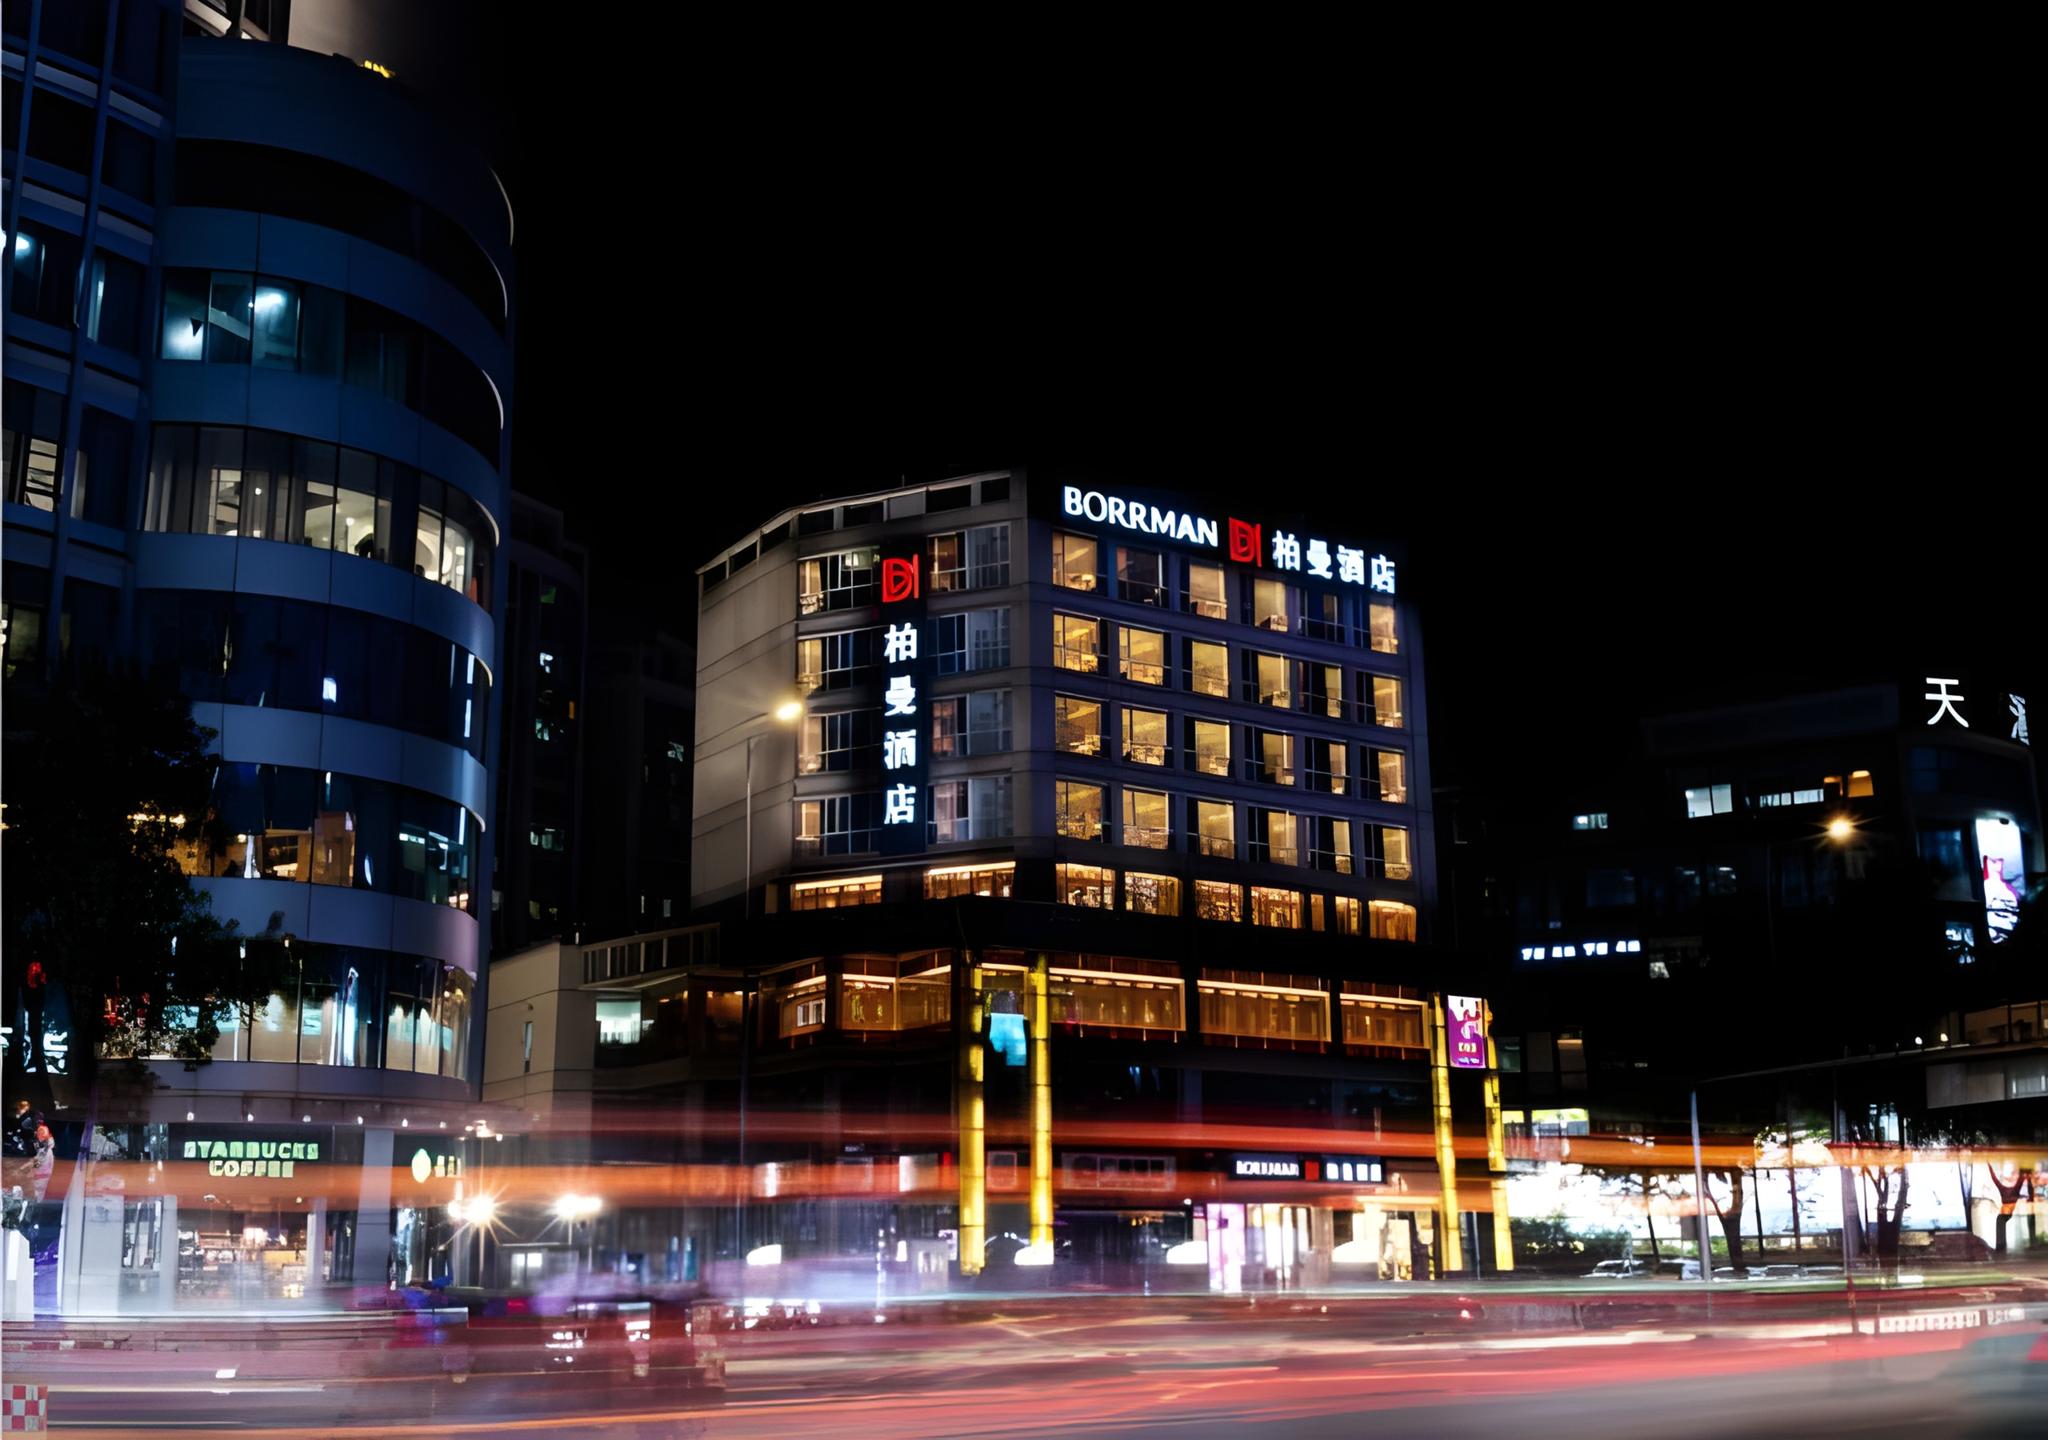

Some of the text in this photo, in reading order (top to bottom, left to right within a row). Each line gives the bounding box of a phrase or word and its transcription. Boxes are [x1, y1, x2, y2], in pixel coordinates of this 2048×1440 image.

[1064, 486, 1218, 547] BORRMAN
[1271, 530, 1396, 594] 柏曼酒店
[883, 622, 918, 825] 柏曼酒店
[1925, 677, 1969, 728] 天
